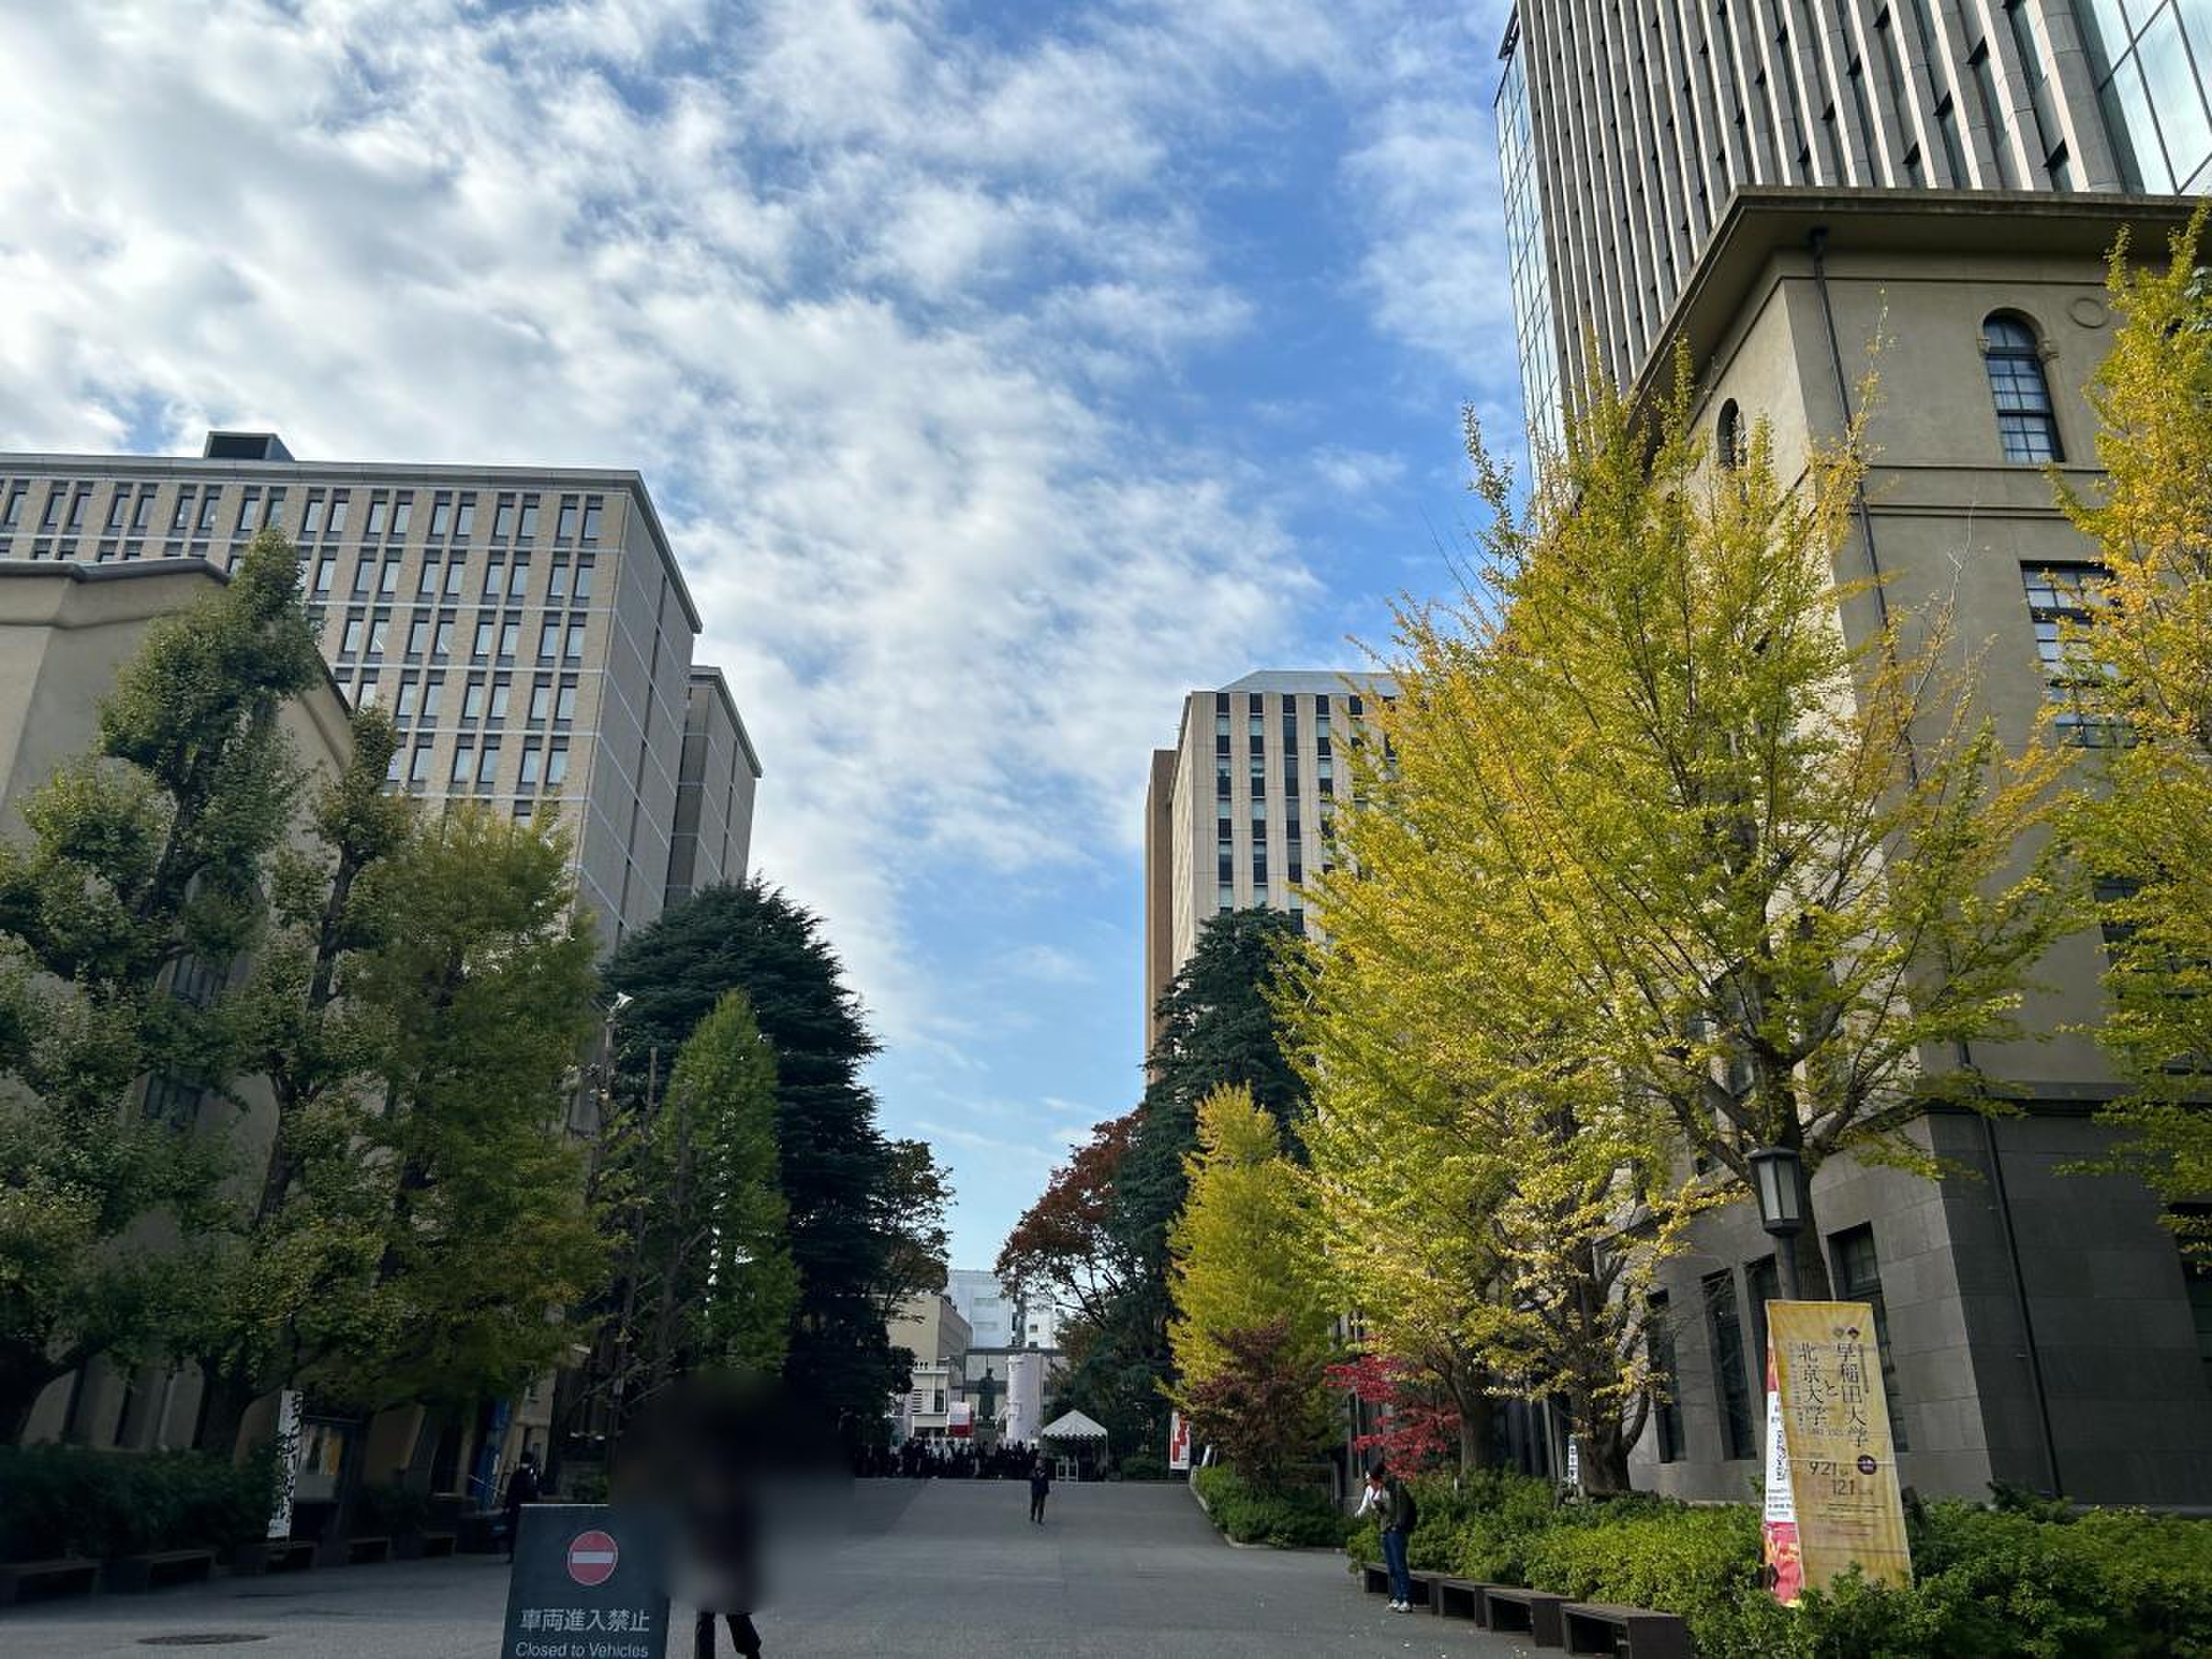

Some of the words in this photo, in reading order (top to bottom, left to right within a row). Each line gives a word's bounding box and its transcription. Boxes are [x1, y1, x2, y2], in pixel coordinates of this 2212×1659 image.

[1799, 1343, 1827, 1426] 北京大学
[1825, 1380, 1839, 1396] と
[1836, 1343, 1868, 1447] 早稲田大学
[520, 1609, 649, 1631] 車両進入禁止
[516, 1641, 566, 1657] Closed
[571, 1642, 584, 1657] to
[588, 1642, 648, 1659] Vehicles
